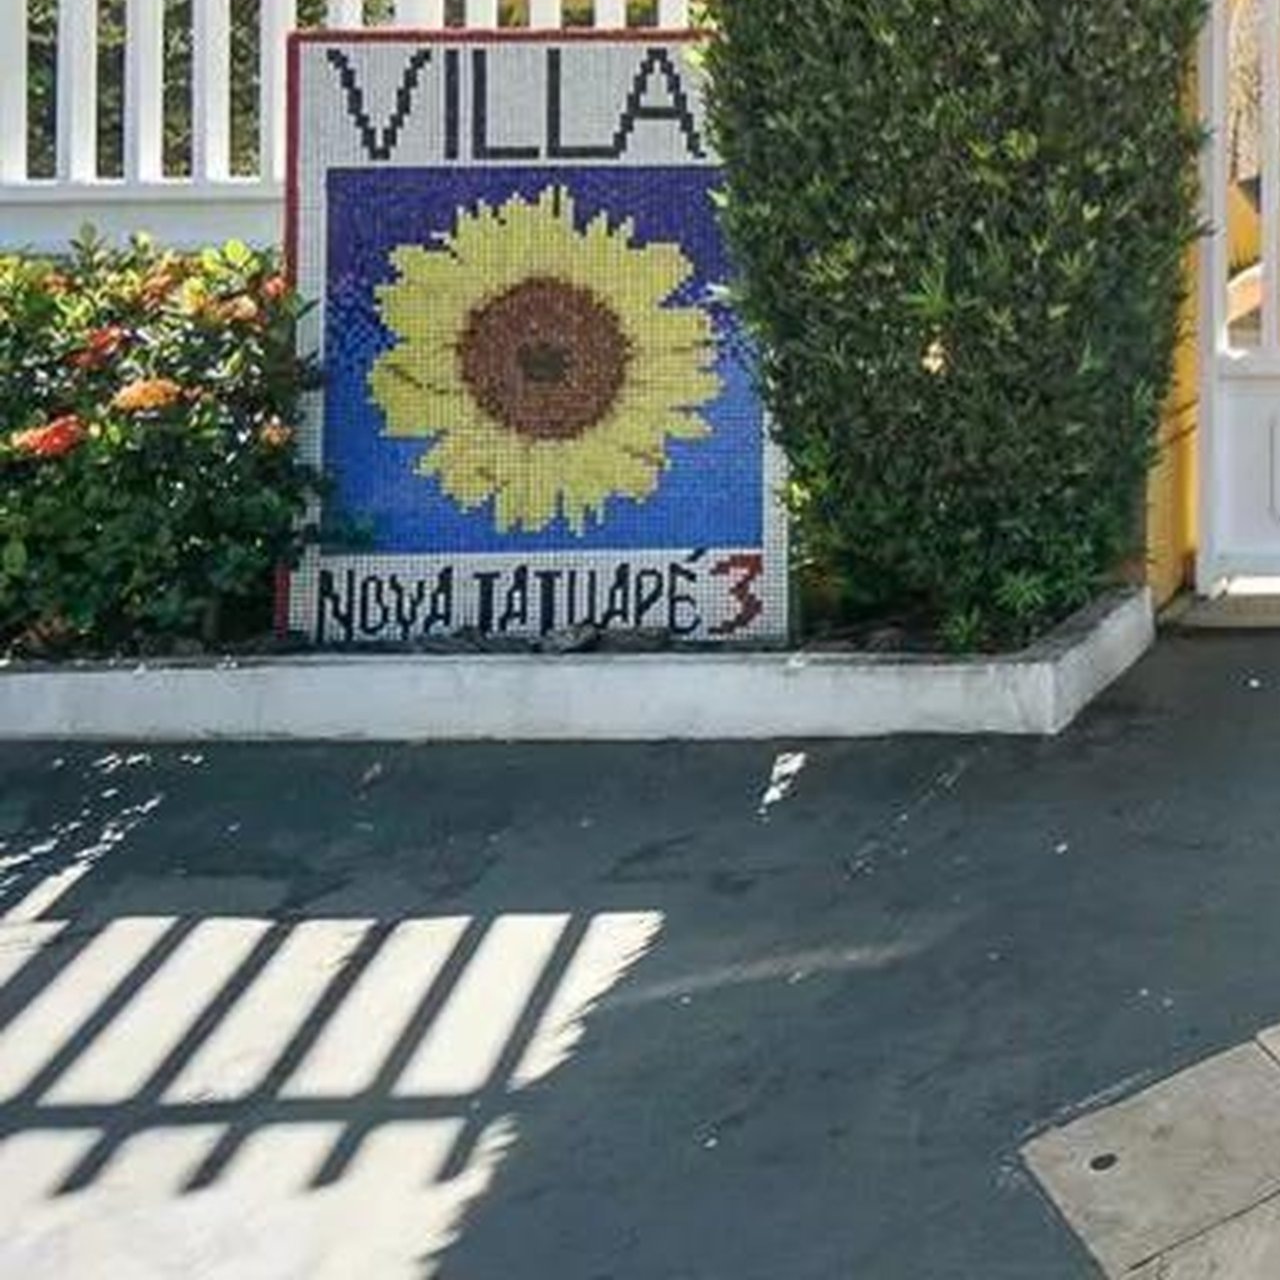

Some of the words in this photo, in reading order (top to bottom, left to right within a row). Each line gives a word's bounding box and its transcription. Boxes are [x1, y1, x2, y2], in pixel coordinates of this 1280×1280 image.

[327, 48, 706, 159] VILLA
[318, 565, 453, 642] NOVA
[473, 548, 702, 637] TATUAPÉ
[708, 553, 763, 635] 3
